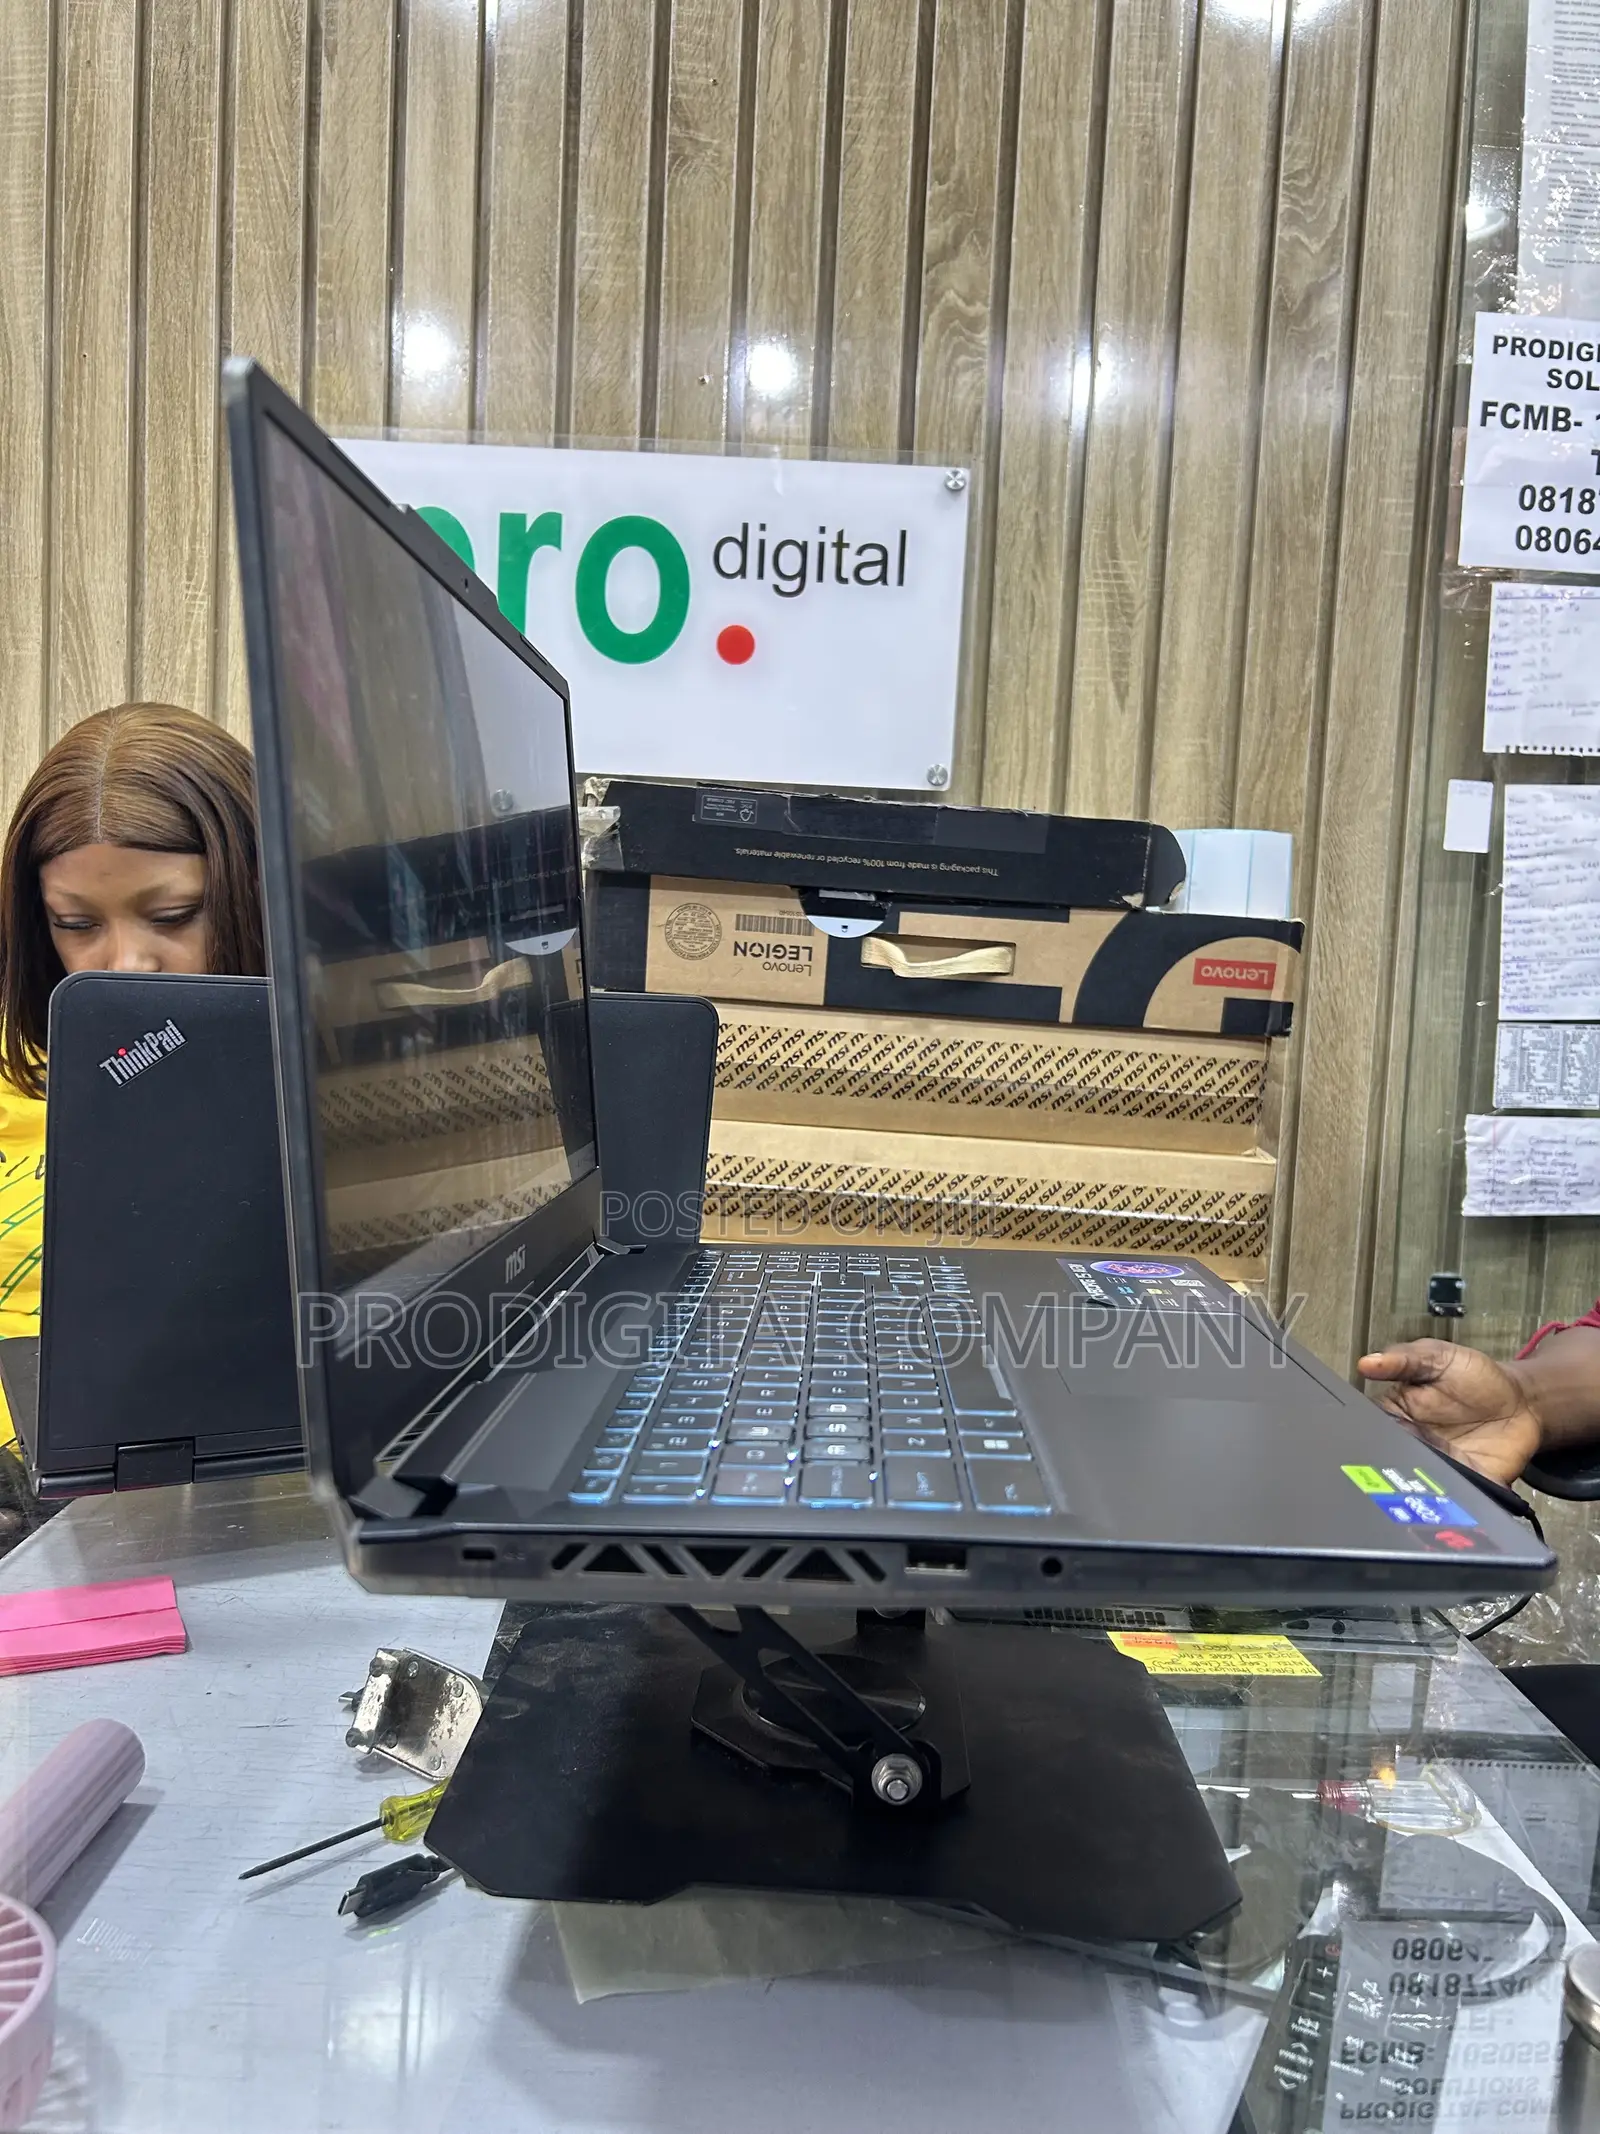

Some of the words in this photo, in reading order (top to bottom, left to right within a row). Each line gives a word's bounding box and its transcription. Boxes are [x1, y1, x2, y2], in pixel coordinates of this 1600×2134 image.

[1480, 400, 1582, 432] FCMB-
[1519, 484, 1600, 515] 0818
[713, 523, 907, 598] digital
[413, 506, 690, 665] ro
[774, 850, 815, 862] renewable
[827, 855, 861, 865] recycled
[863, 859, 885, 868] 100%
[886, 860, 906, 870] from
[907, 862, 930, 871] made
[940, 863, 980, 874] packaging
[982, 867, 999, 877] This
[733, 941, 813, 961] LEGION
[762, 961, 812, 977] Lenovo
[1202, 965, 1268, 984] Lenovo
[99, 1018, 187, 1085] ThinkPad
[735, 1052, 758, 1076] msi
[760, 1030, 782, 1054] msi
[737, 1032, 759, 1056] msi
[758, 1050, 781, 1075] msi
[782, 1028, 805, 1052] msi
[825, 1065, 848, 1089] msi
[850, 1043, 872, 1067] msi
[848, 1063, 871, 1088] msi
[872, 1041, 895, 1066] msi
[871, 1061, 894, 1086] msi
[895, 1039, 918, 1064] msi
[894, 1060, 917, 1084] msi
[918, 1037, 941, 1062] msi
[757, 1070, 779, 1094] msi
[781, 1048, 803, 1073] msi
[780, 1068, 802, 1092] msi
[804, 1047, 826, 1071] msi
[802, 1067, 825, 1091] msi
[827, 1045, 849, 1069] msi
[892, 1079, 915, 1103] msi
[917, 1058, 940, 1082] msi
[915, 1077, 938, 1102] msi
[940, 1056, 963, 1080] msi
[938, 1075, 961, 1100] msi
[963, 1054, 986, 1078] msi
[961, 1074, 984, 1098] msi
[986, 1052, 1009, 1076] msi
[985, 1072, 1007, 1097] msi
[1009, 1050, 1032, 1075] msi
[1008, 1071, 1030, 1095] msi
[1033, 1048, 1055, 1073] msi
[1029, 1088, 1051, 1112] msi
[1055, 1067, 1077, 1092] msi
[1031, 1069, 1054, 1093] msi
[1056, 1047, 1078, 1071] msi
[1052, 1087, 1075, 1111] msi
[1078, 1065, 1100, 1090] msi
[1076, 1085, 1098, 1110] msi
[1101, 1064, 1124, 1088] msi
[1099, 1084, 1122, 1108] msi
[1124, 1062, 1147, 1086] msi
[1123, 1082, 1145, 1107] msi
[1148, 1060, 1170, 1084] msi
[1146, 1080, 1168, 1105] msi
[1171, 1058, 1194, 1082] msi
[1170, 1079, 1192, 1103] msi
[1194, 1056, 1217, 1081] msi
[1167, 1098, 1189, 1122] msi
[1193, 1077, 1215, 1101] msi
[1190, 1097, 1213, 1121] msi
[1216, 1075, 1239, 1100] msi
[1214, 1095, 1236, 1120] msi
[505, 1244, 526, 1284] msi
